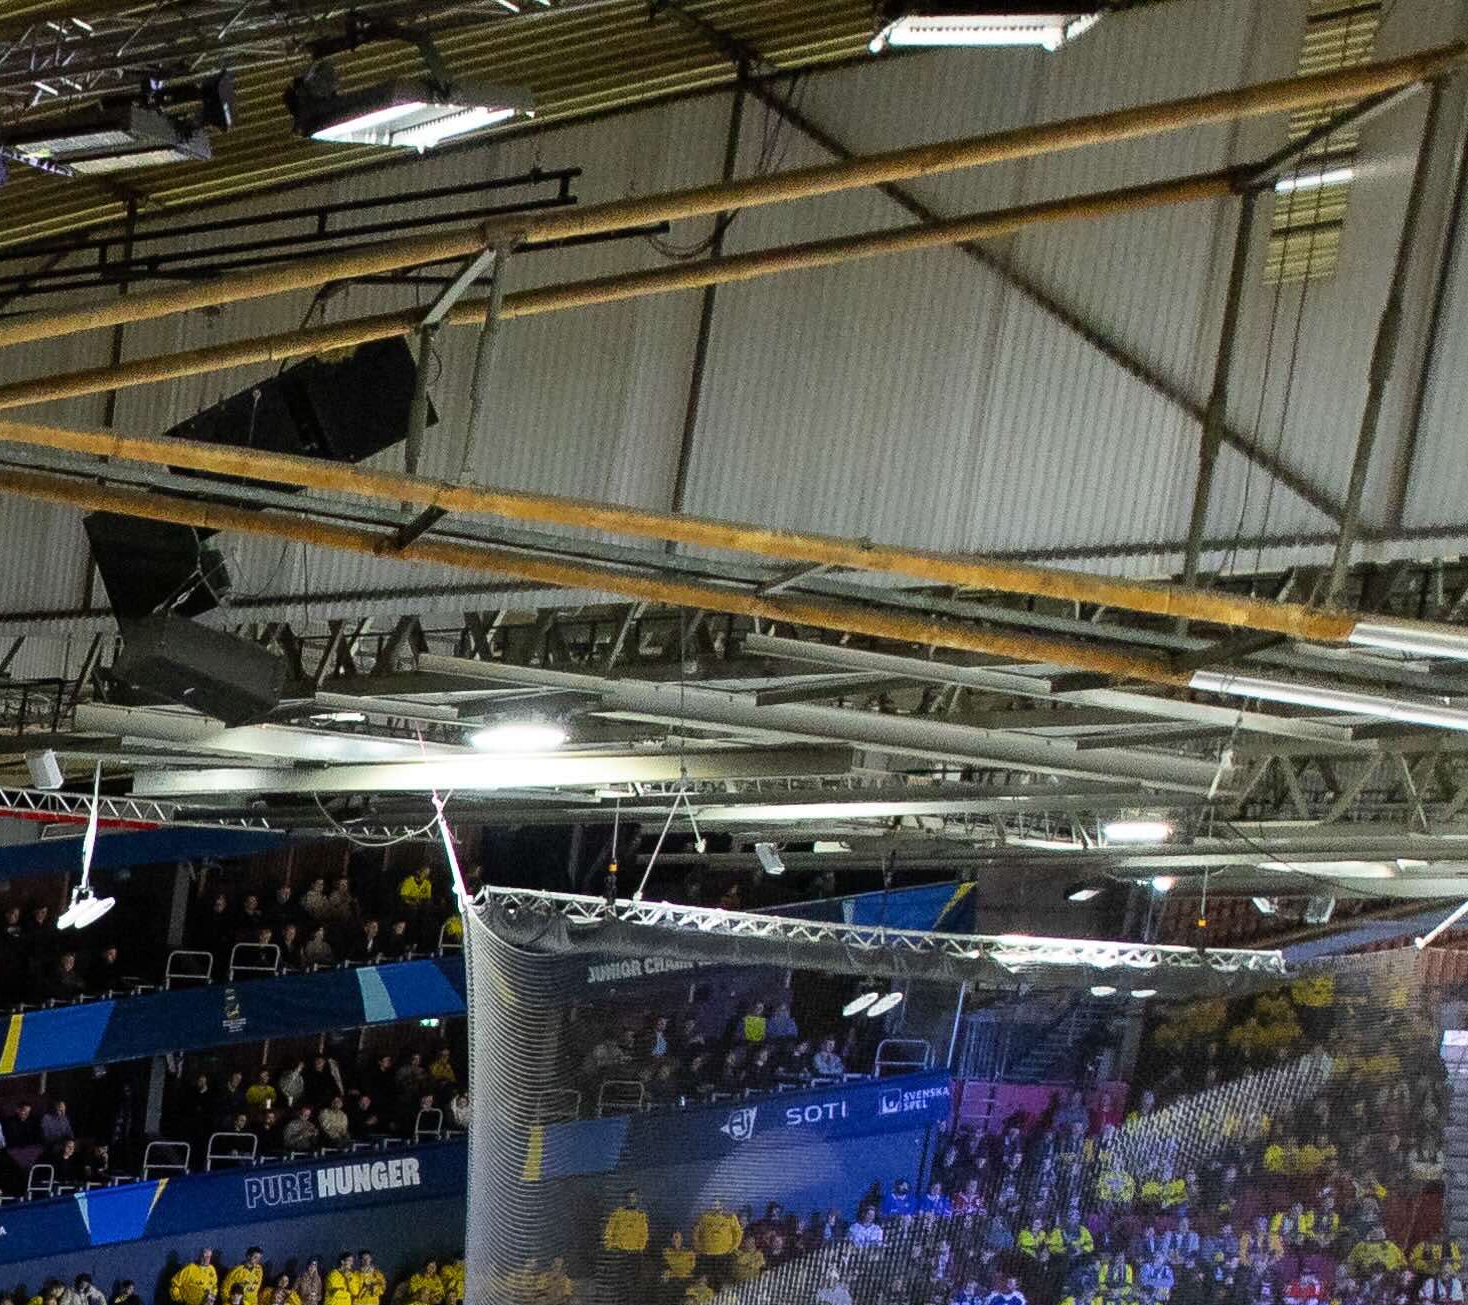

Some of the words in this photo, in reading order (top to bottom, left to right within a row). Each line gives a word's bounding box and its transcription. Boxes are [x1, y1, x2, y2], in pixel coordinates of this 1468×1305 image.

[902, 1086, 950, 1101] SVENSKA
[785, 1100, 847, 1126] SOTI
[244, 1169, 314, 1209] PURE
[316, 1156, 422, 1199] HUNGER
